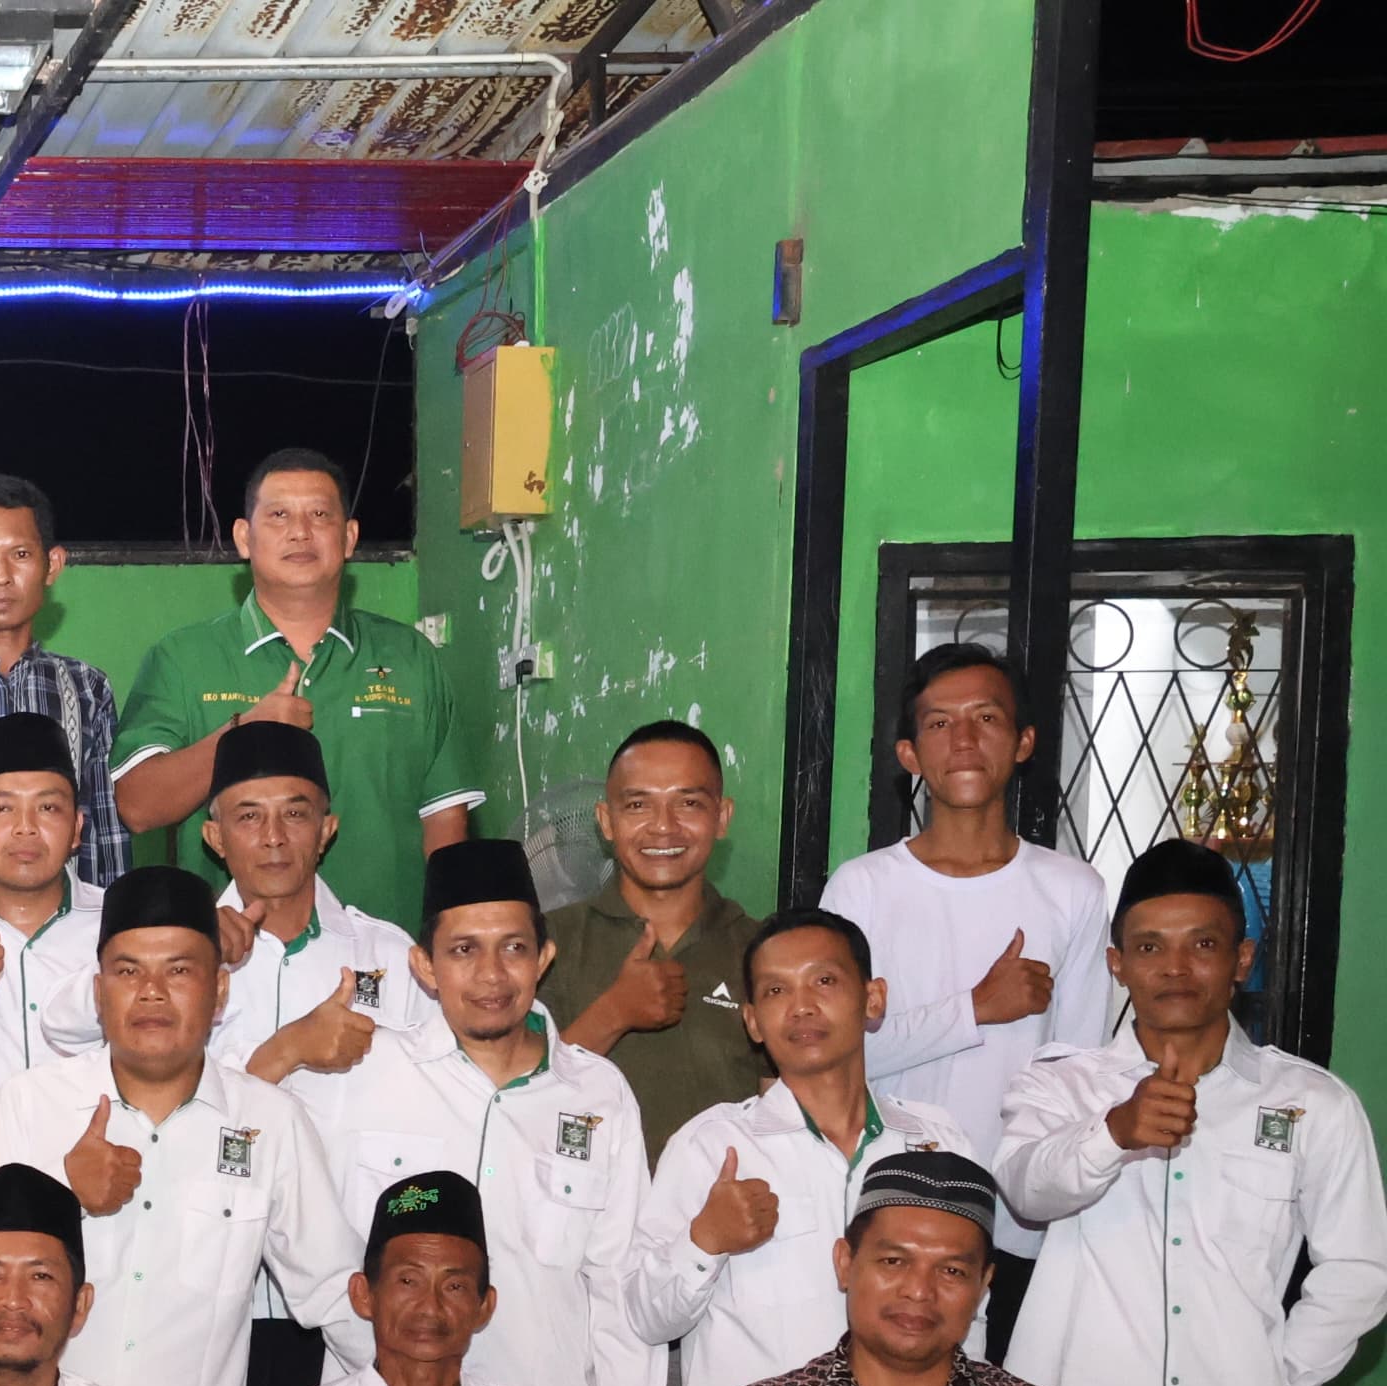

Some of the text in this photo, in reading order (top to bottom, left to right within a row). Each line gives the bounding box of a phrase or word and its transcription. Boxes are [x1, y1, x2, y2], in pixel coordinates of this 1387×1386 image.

[368, 685, 395, 693] TEAM
[203, 693, 218, 701] EKO
[1257, 1138, 1288, 1151] PKB
[558, 1147, 588, 1160] PKB
[219, 1164, 248, 1176] PKB
